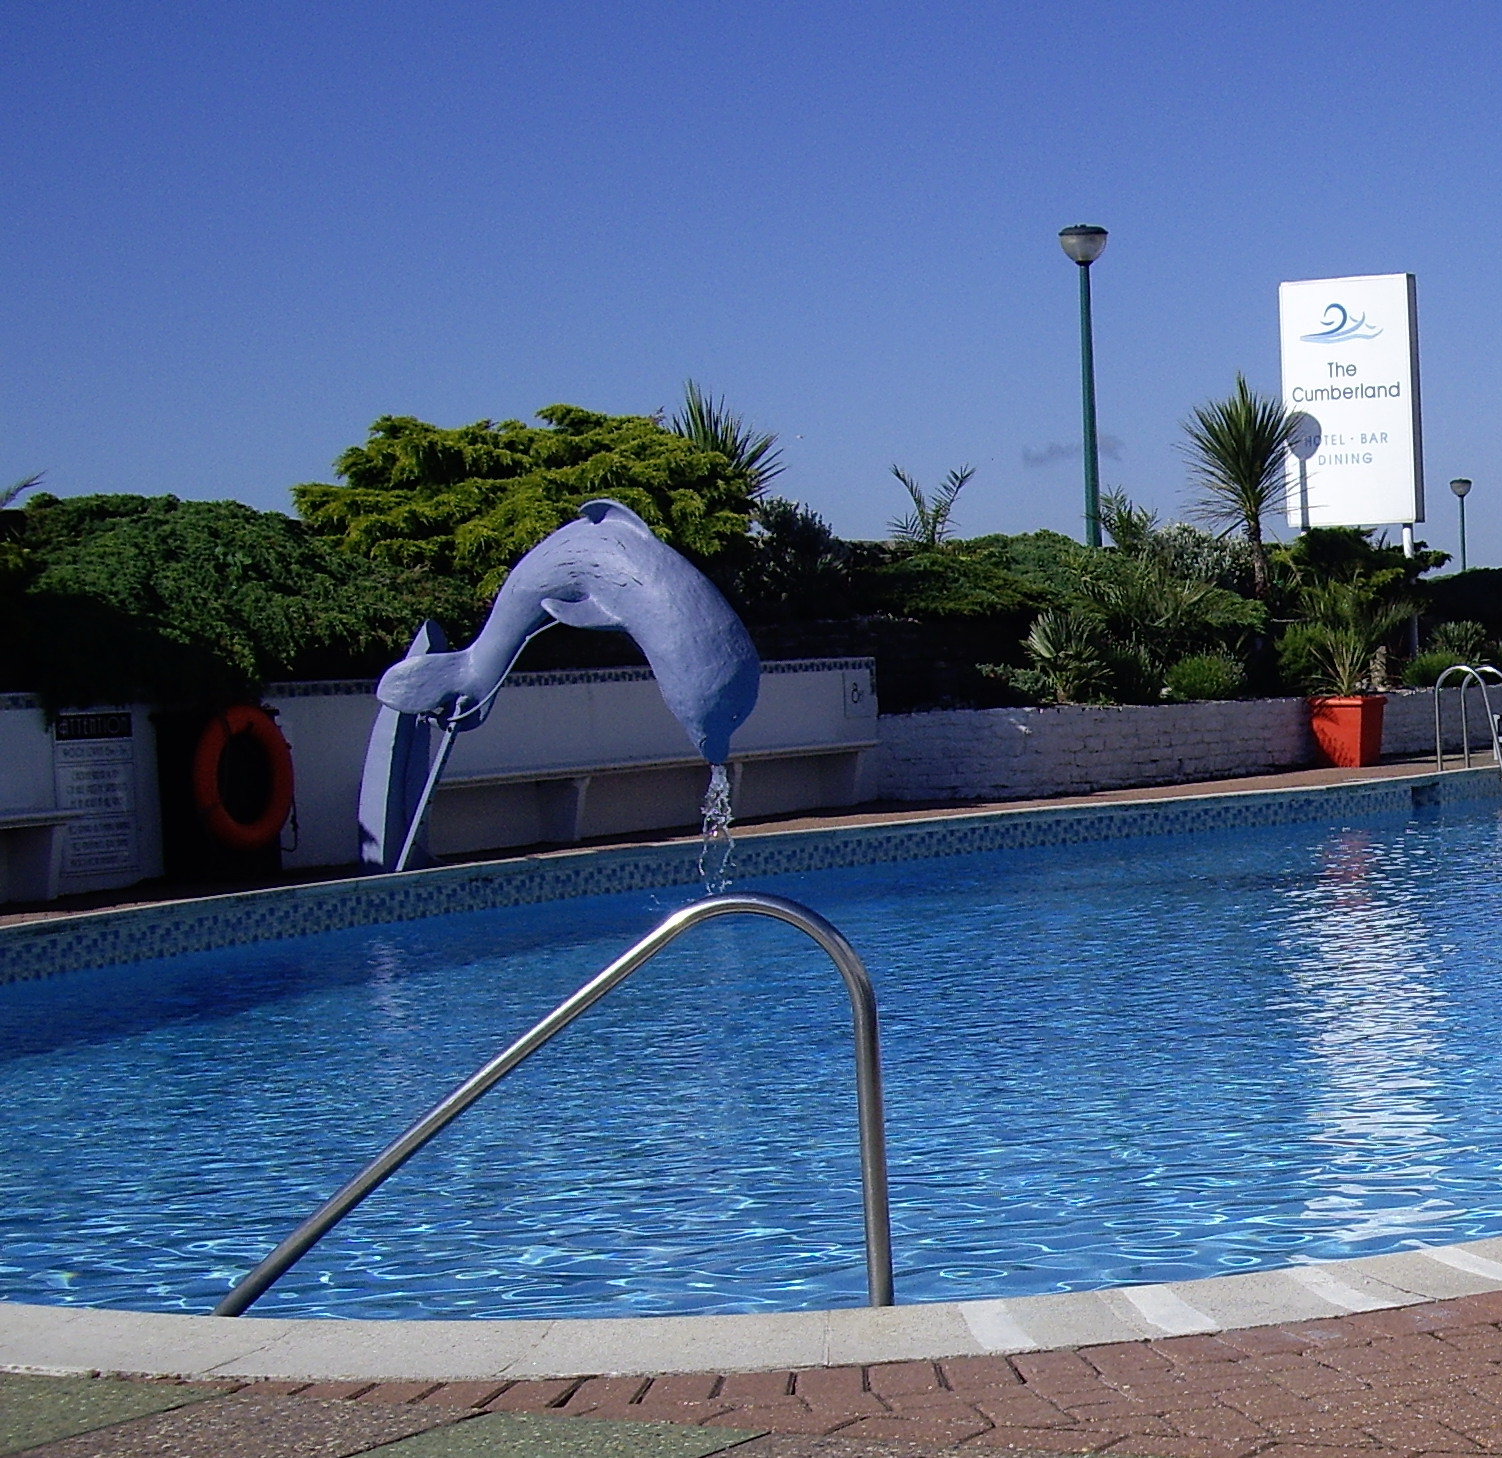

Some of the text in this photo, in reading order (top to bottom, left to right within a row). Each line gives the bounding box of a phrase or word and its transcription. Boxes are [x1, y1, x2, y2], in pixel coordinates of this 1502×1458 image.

[1327, 362, 1357, 378] The
[1292, 381, 1400, 402] Cumberland
[1304, 432, 1388, 447] HOTEL BAR
[1318, 452, 1373, 466] DINING
